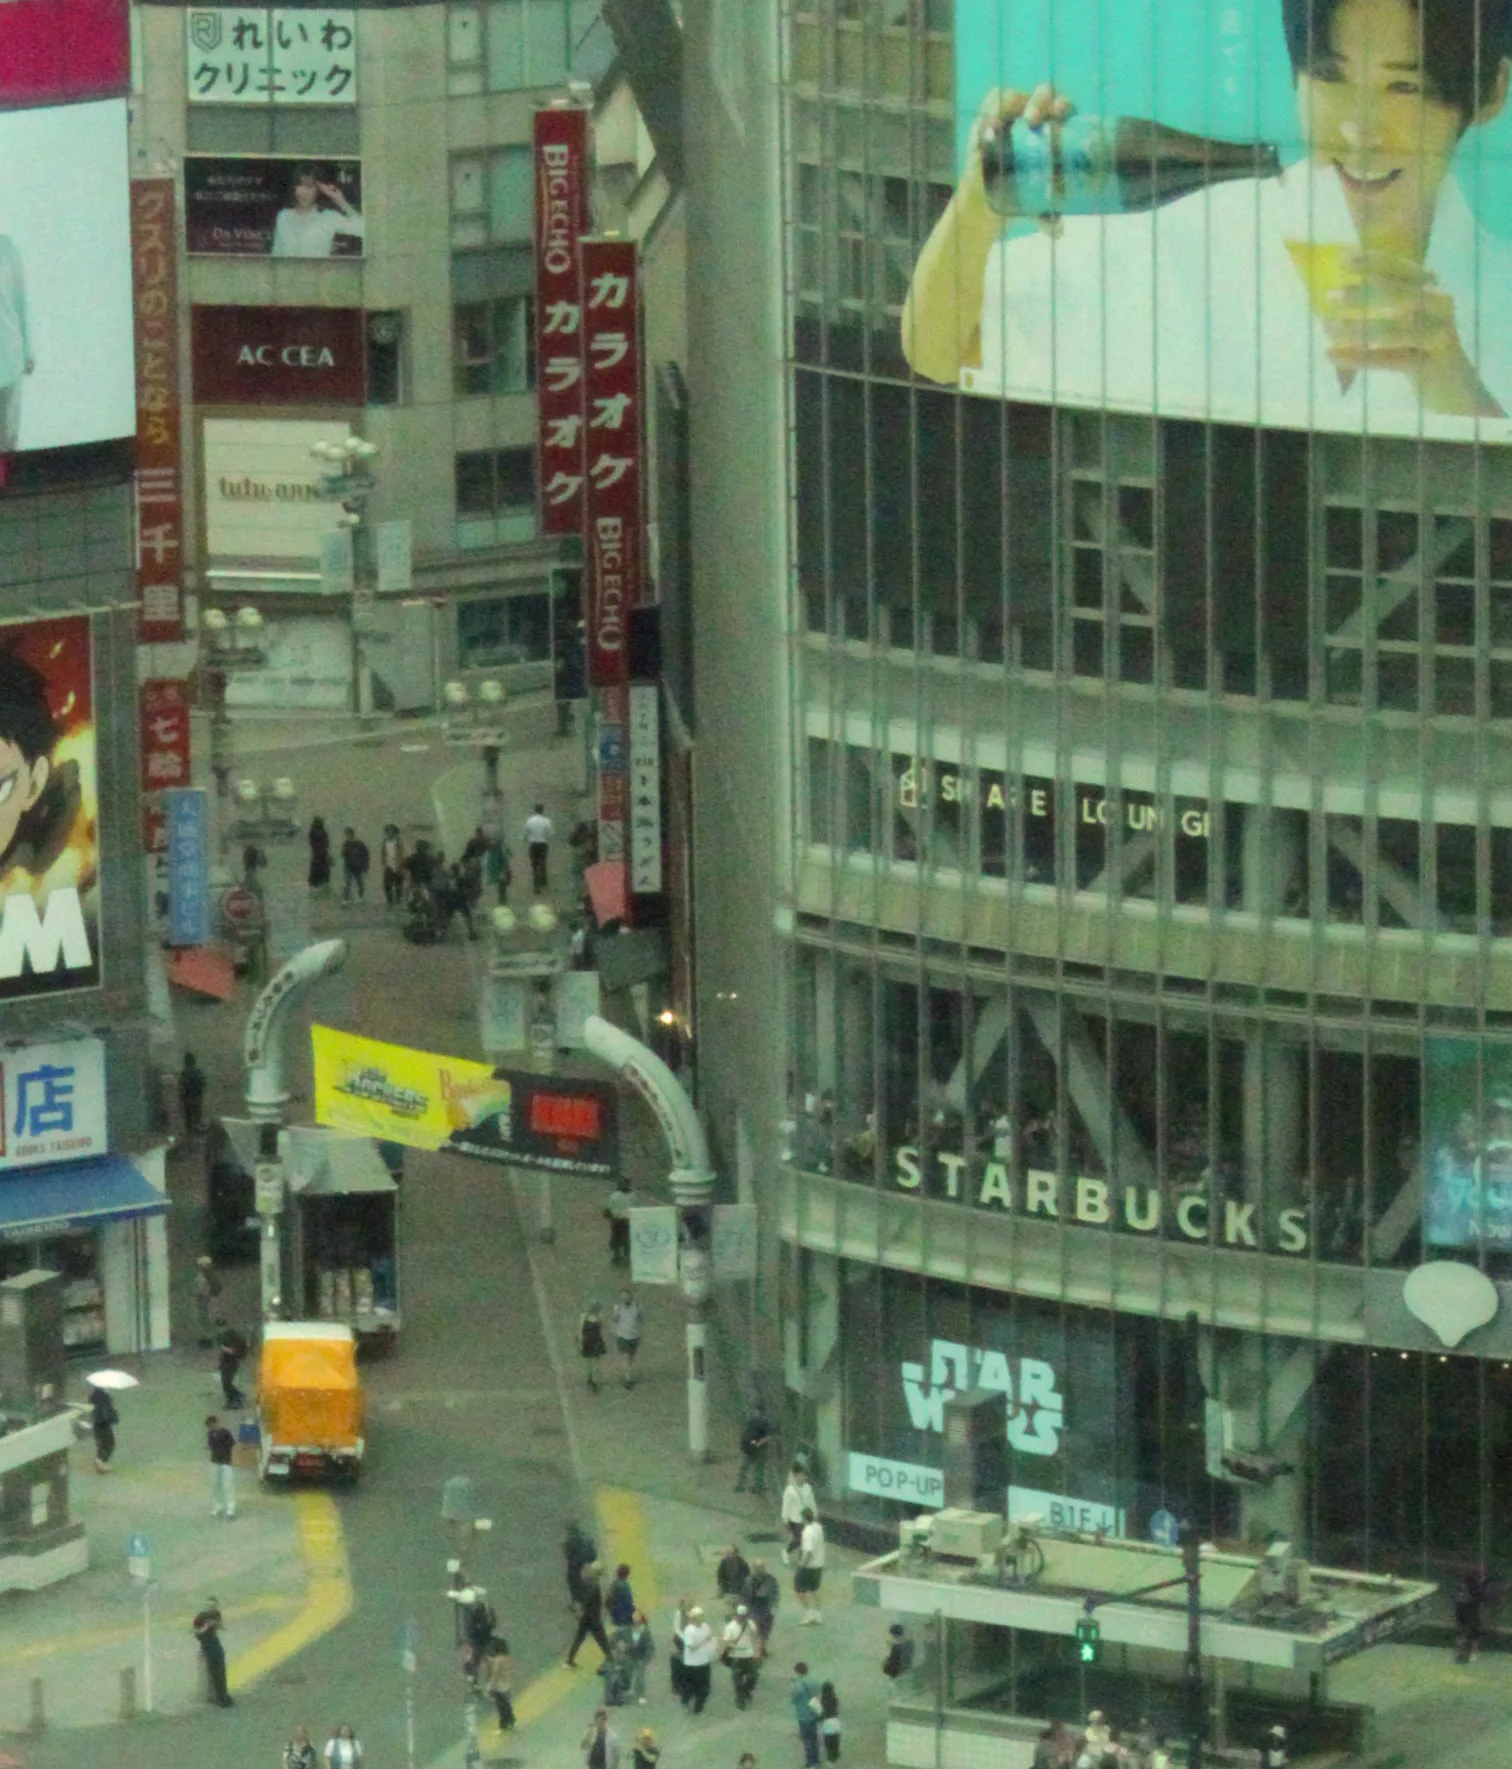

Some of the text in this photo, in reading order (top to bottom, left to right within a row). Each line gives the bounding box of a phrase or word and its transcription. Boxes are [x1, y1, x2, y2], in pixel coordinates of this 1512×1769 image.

[193, 61, 352, 96] クリニック
[232, 15, 353, 52] れいわ
[543, 144, 571, 275] BIG ECHO
[542, 300, 584, 506] カラオケ
[589, 271, 634, 491] カラオケ
[596, 516, 623, 650] BIG ECHO
[894, 1144, 1310, 1253] STARBUCKS
[865, 1464, 943, 1497] POP-UP
